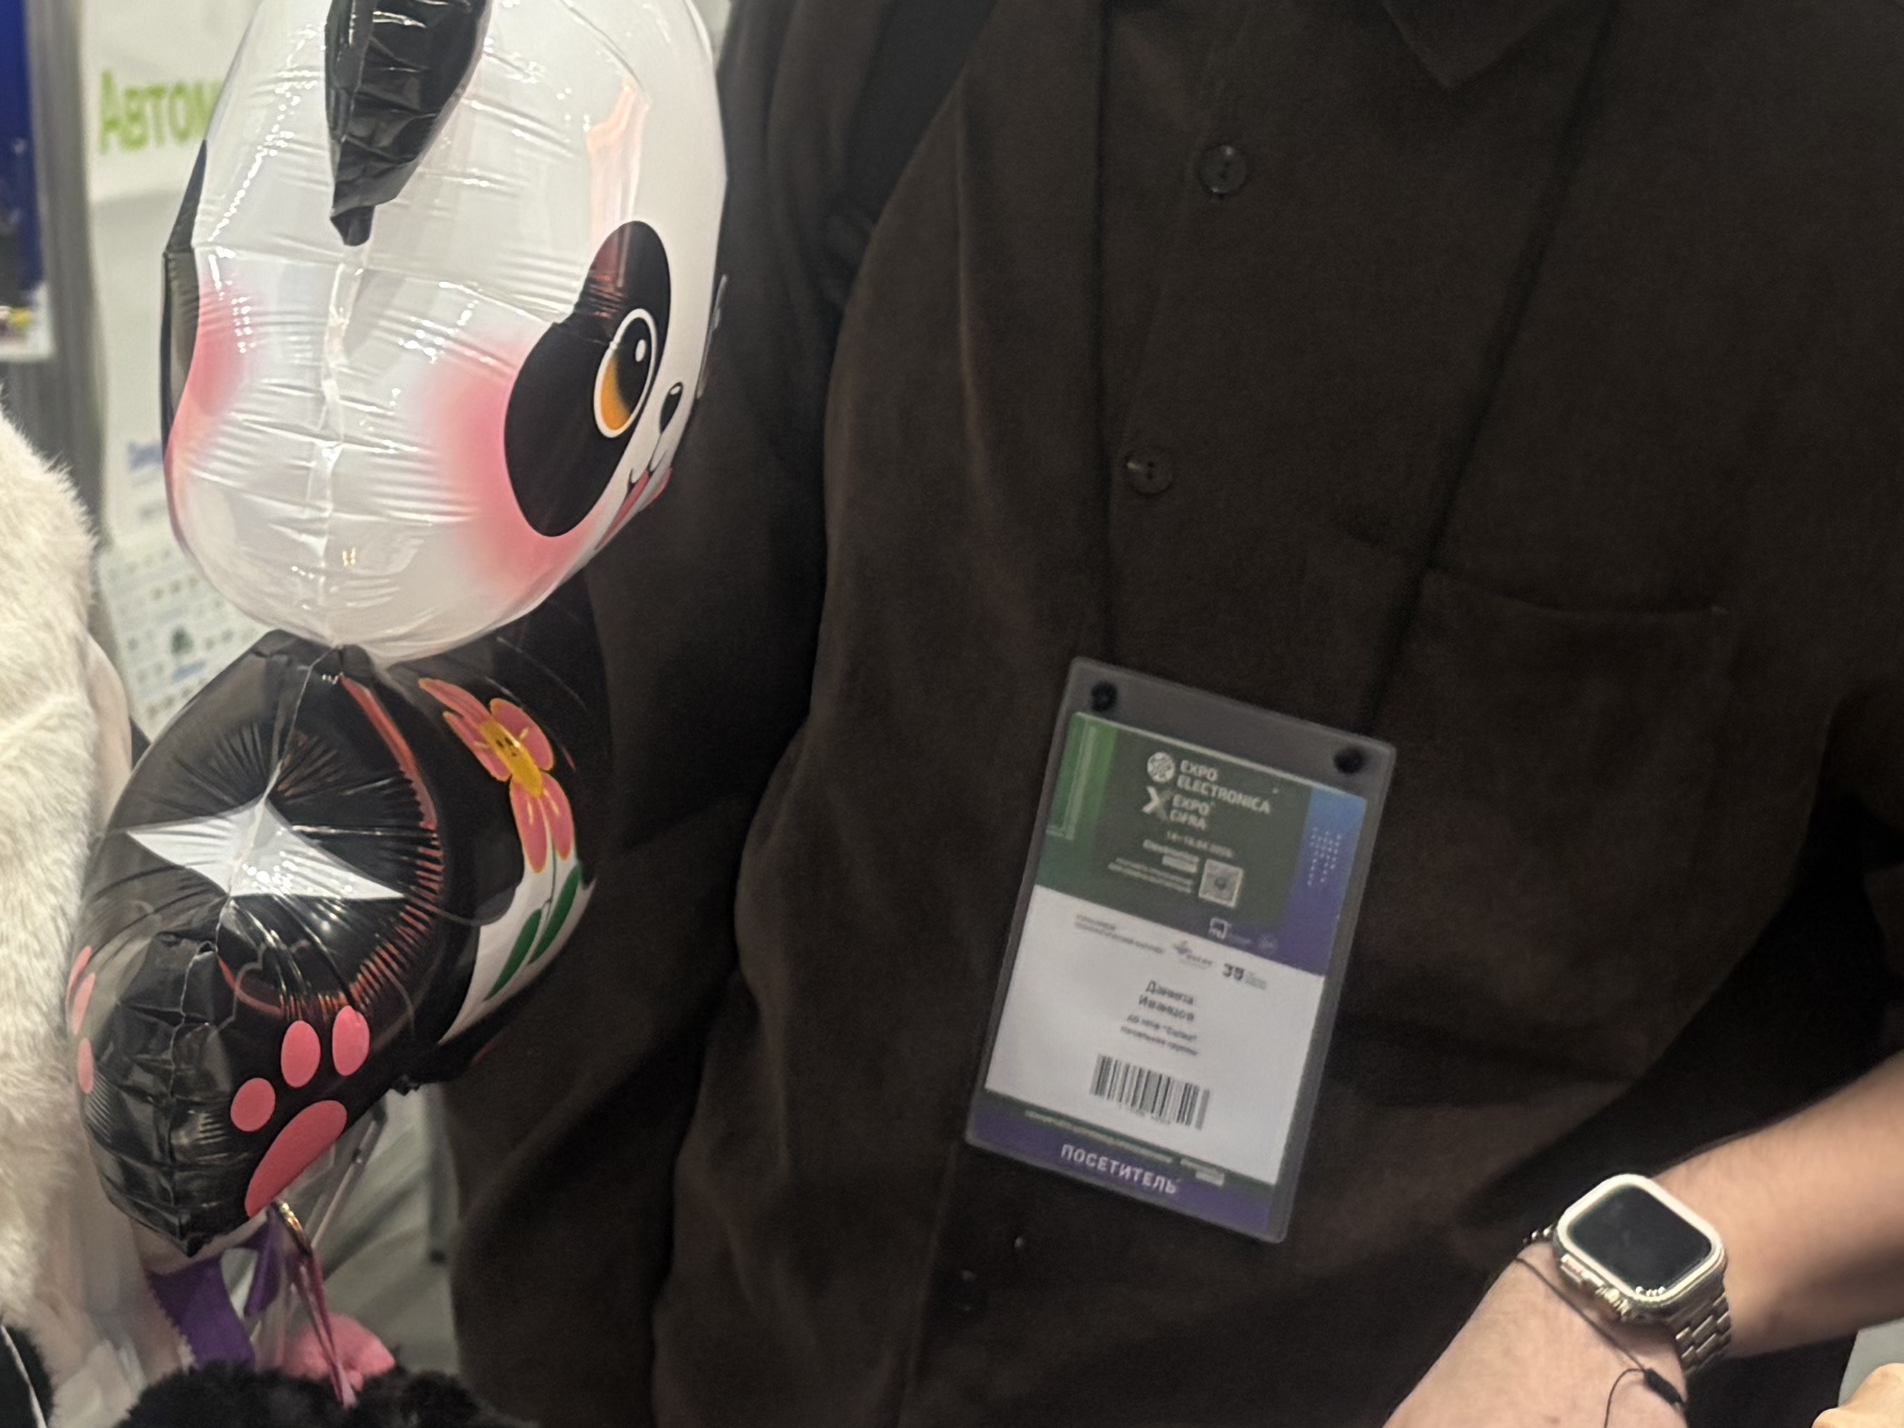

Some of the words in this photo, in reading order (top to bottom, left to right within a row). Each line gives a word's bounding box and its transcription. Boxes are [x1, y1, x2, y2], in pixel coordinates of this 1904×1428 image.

[1180, 760, 1218, 782] EXPO
[1172, 794, 1210, 816] EXPO
[1177, 775, 1271, 814] ELECTRONICA
[1060, 1143, 1177, 1194] ПОСЕТИТЕЛЬ
